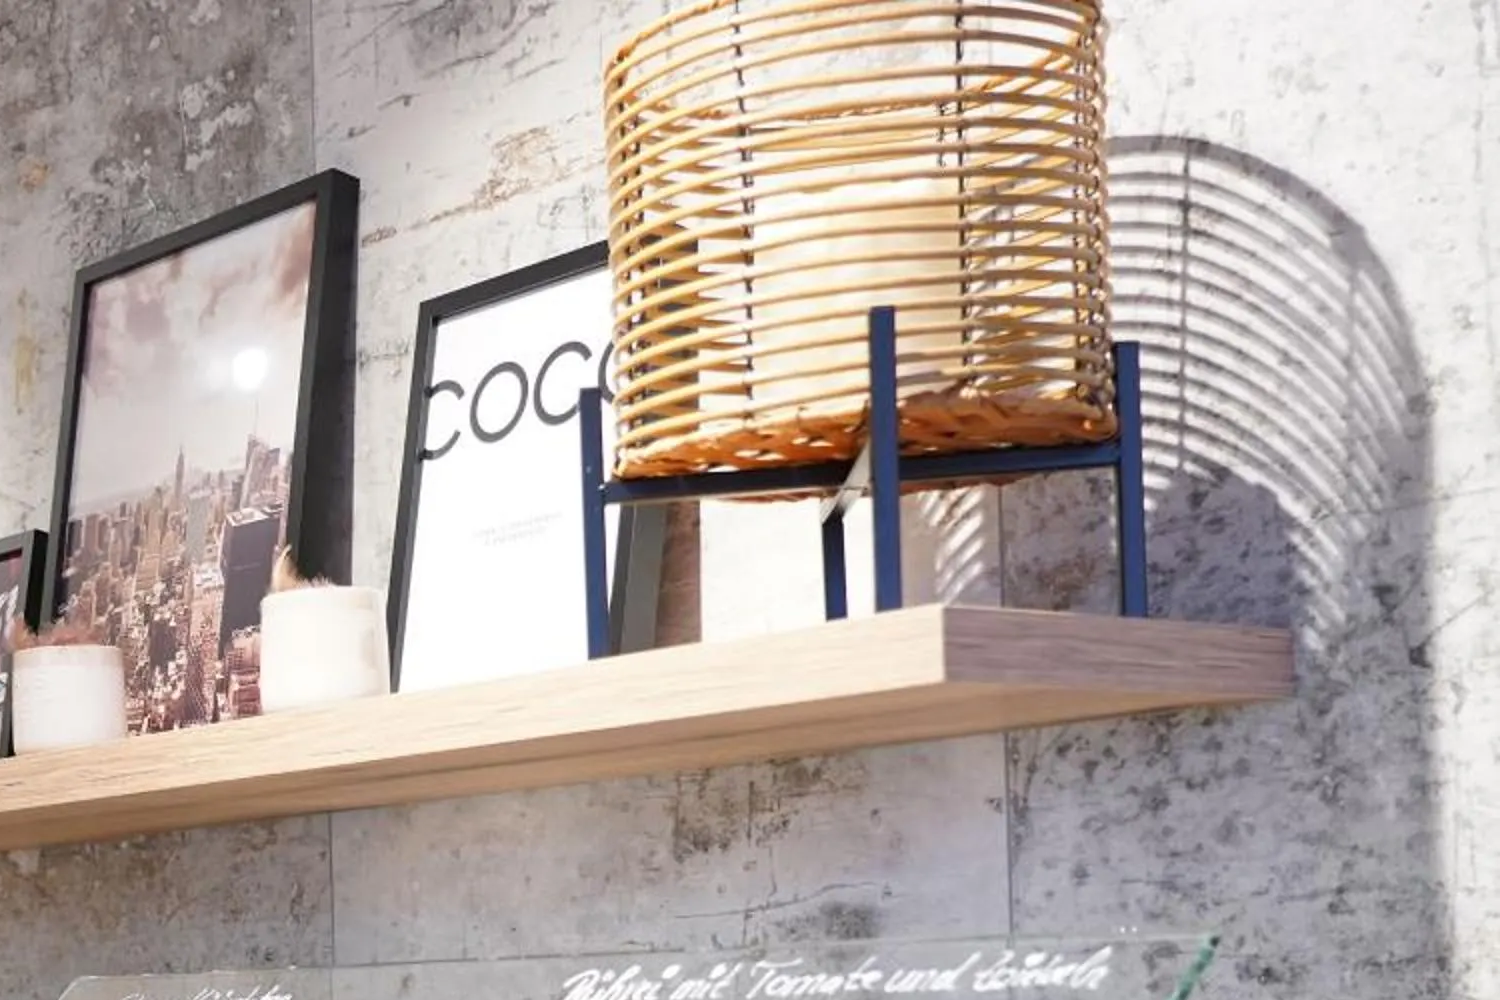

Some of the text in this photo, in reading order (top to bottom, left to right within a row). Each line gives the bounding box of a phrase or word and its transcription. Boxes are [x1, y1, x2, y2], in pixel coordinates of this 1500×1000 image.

[421, 341, 613, 461] COC
[669, 962, 744, 1000] mit
[746, 956, 883, 999] Tomate
[884, 951, 981, 993] und
